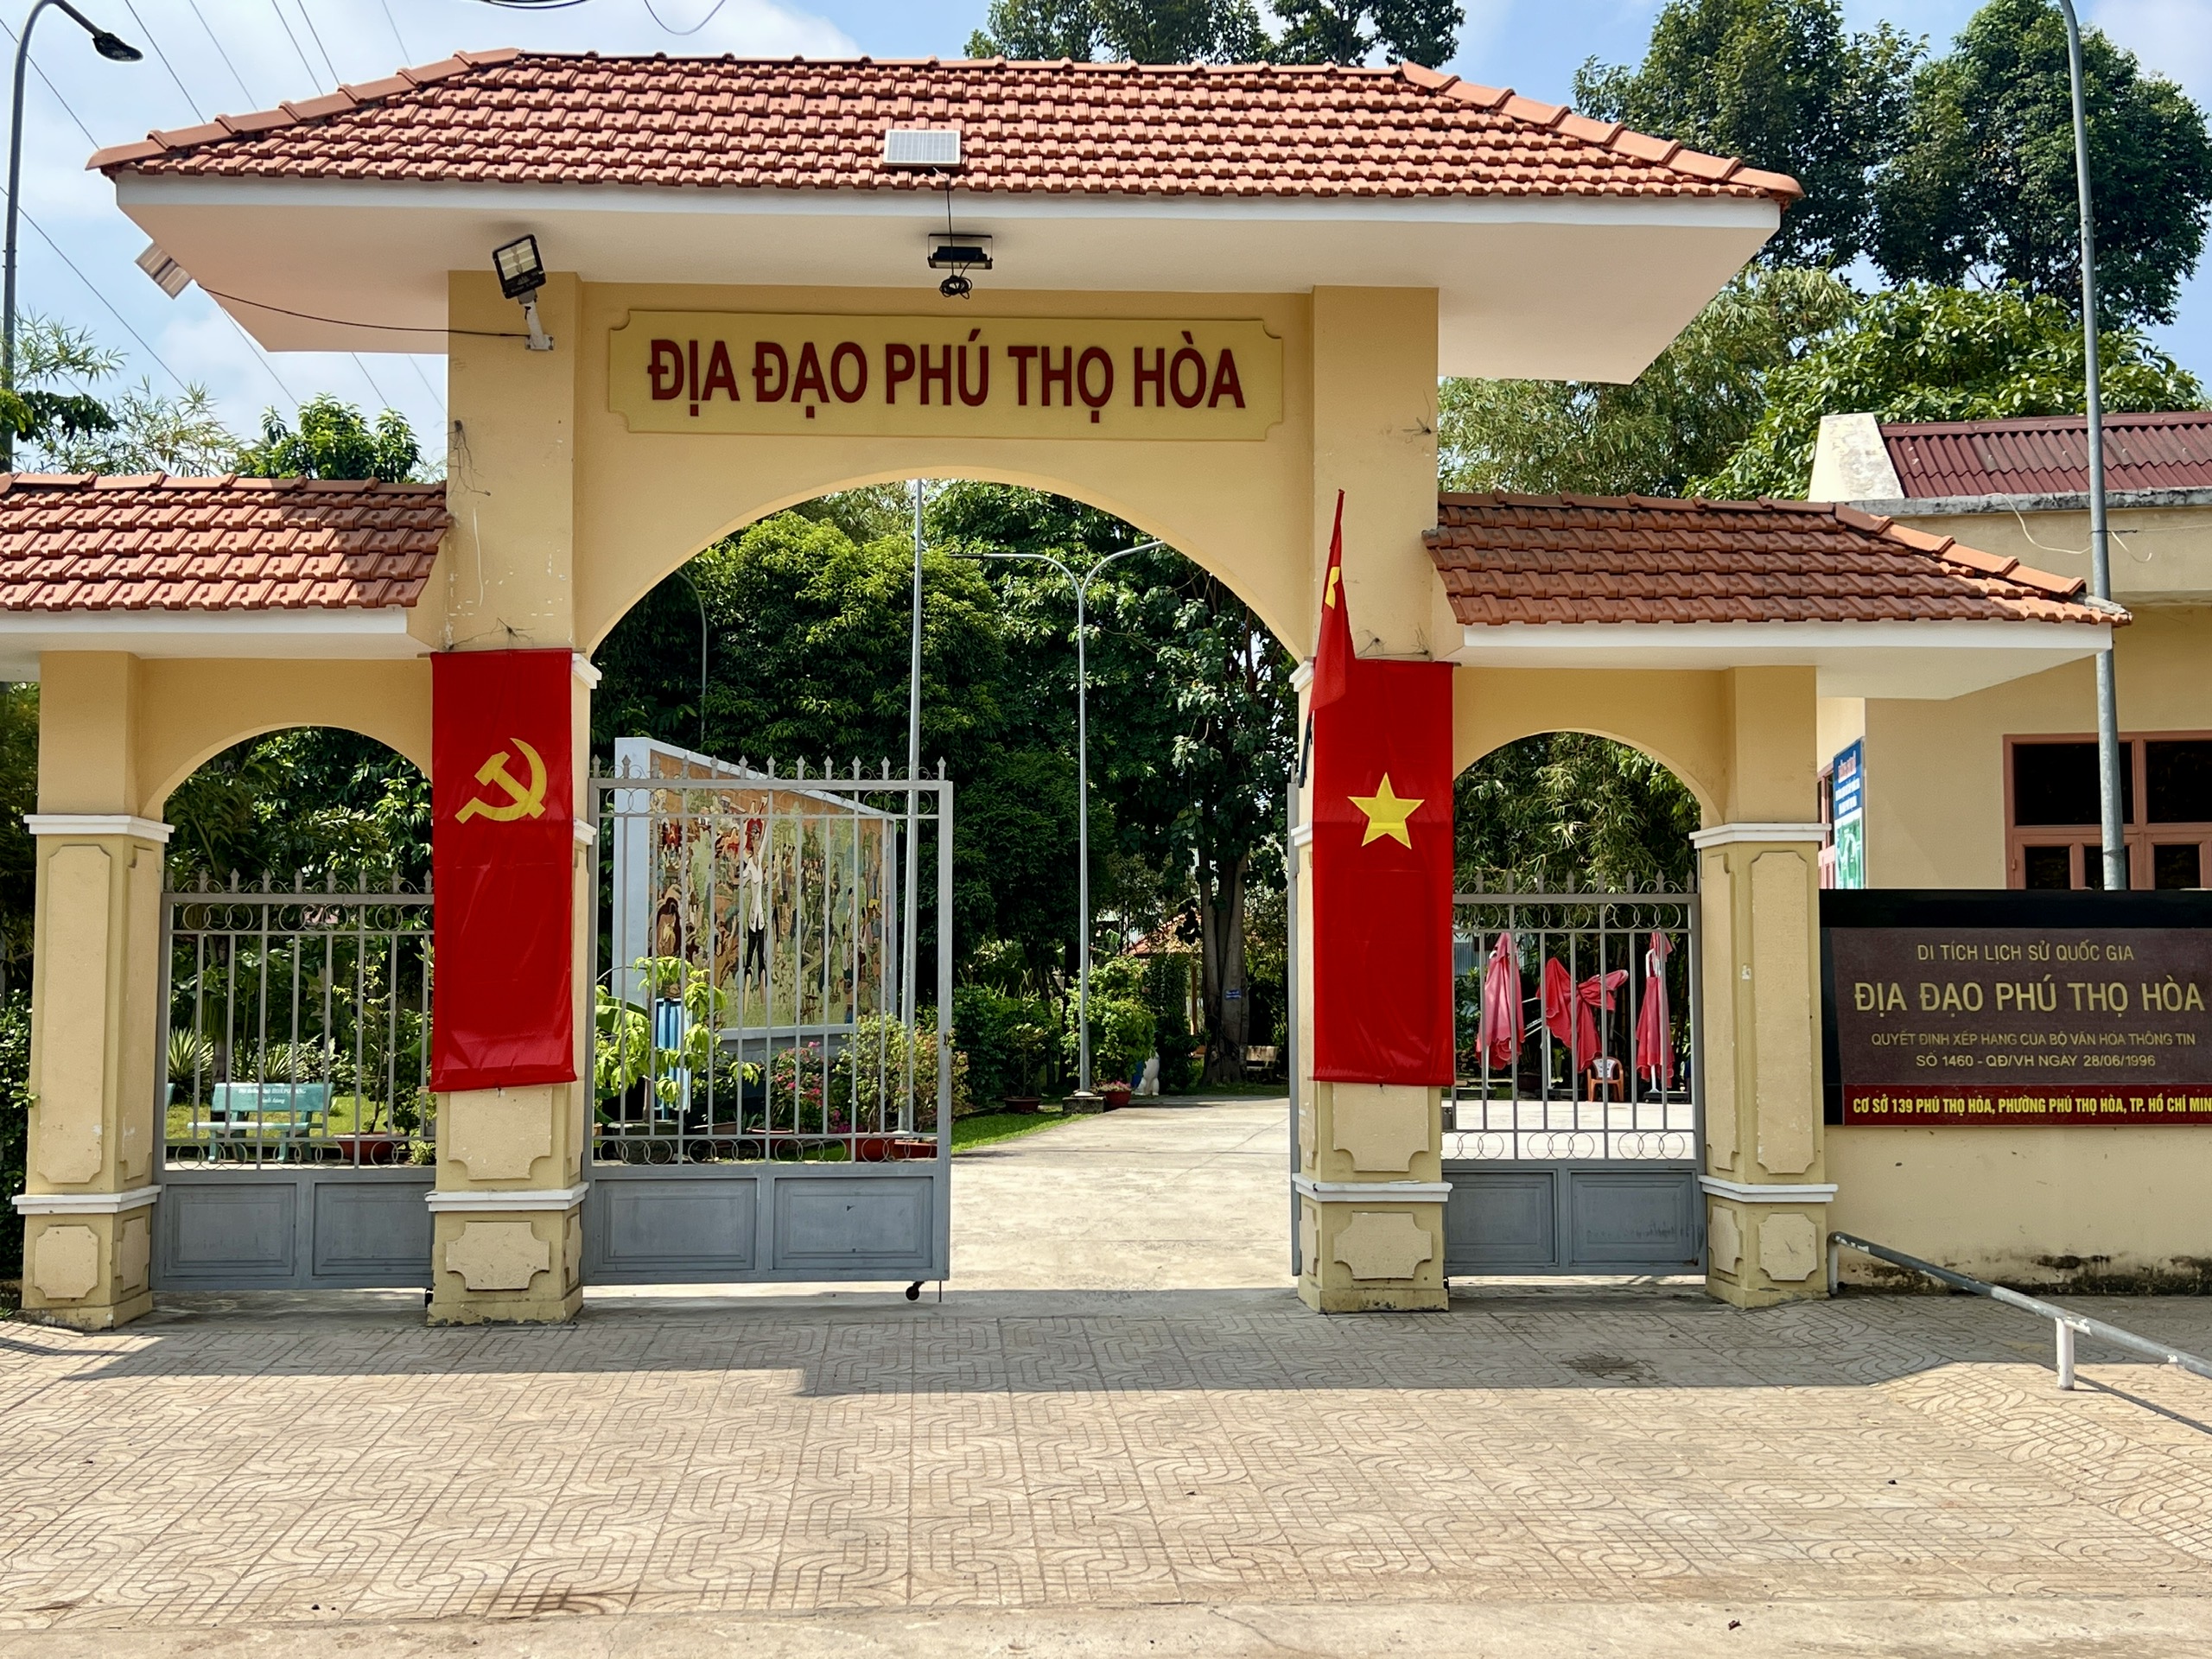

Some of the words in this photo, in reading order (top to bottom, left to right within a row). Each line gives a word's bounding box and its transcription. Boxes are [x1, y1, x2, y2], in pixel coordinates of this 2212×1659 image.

[647, 339, 741, 416] ĐỊA
[752, 341, 868, 419] ĐẠO
[885, 328, 989, 406] PHÚ
[1007, 346, 1114, 423] THỌ
[1134, 330, 1246, 409] HÒA
[1917, 944, 1935, 961] DI
[1940, 940, 1979, 961] TÍCH
[1984, 944, 2022, 965] LỊCH
[2028, 940, 2050, 962] SỬ
[2056, 939, 2100, 962] QUỐC
[2106, 944, 2134, 961] GIA
[1854, 982, 1908, 1017] ĐỊA
[1919, 982, 1984, 1017] ĐẠO
[1995, 974, 2057, 1012] PHÚ
[2067, 982, 2129, 1017] THỌ
[2141, 975, 2205, 1012] HÒA
[2128, 1030, 2173, 1046] THÔNG
[2175, 1033, 2196, 1046] TIN
[1916, 1049, 1938, 1067] SỐ
[1942, 1054, 1974, 1067] 1460
[1986, 1054, 2035, 1068] QĐ/VH
[2082, 1054, 2156, 1067] 28/06/1996
[1853, 1096, 1870, 1114] CƠ
[1872, 1093, 1889, 1114] SỞ
[1891, 1098, 1913, 1114] 139
[1916, 1095, 1940, 1114] PHÚ
[1942, 1097, 1965, 1117] THỌ
[1968, 1095, 1996, 1116] HÒA,
[1999, 1095, 2046, 1114] PHƯỜNG
[2049, 1095, 2072, 1113] PHÚ
[2075, 1097, 2097, 1116] THỌ
[2100, 1094, 2127, 1114] HÒA,
[2129, 1097, 2145, 1113] TP.
[2167, 1094, 2187, 1113] CHÍ
[2189, 1097, 2212, 1113] MIN
